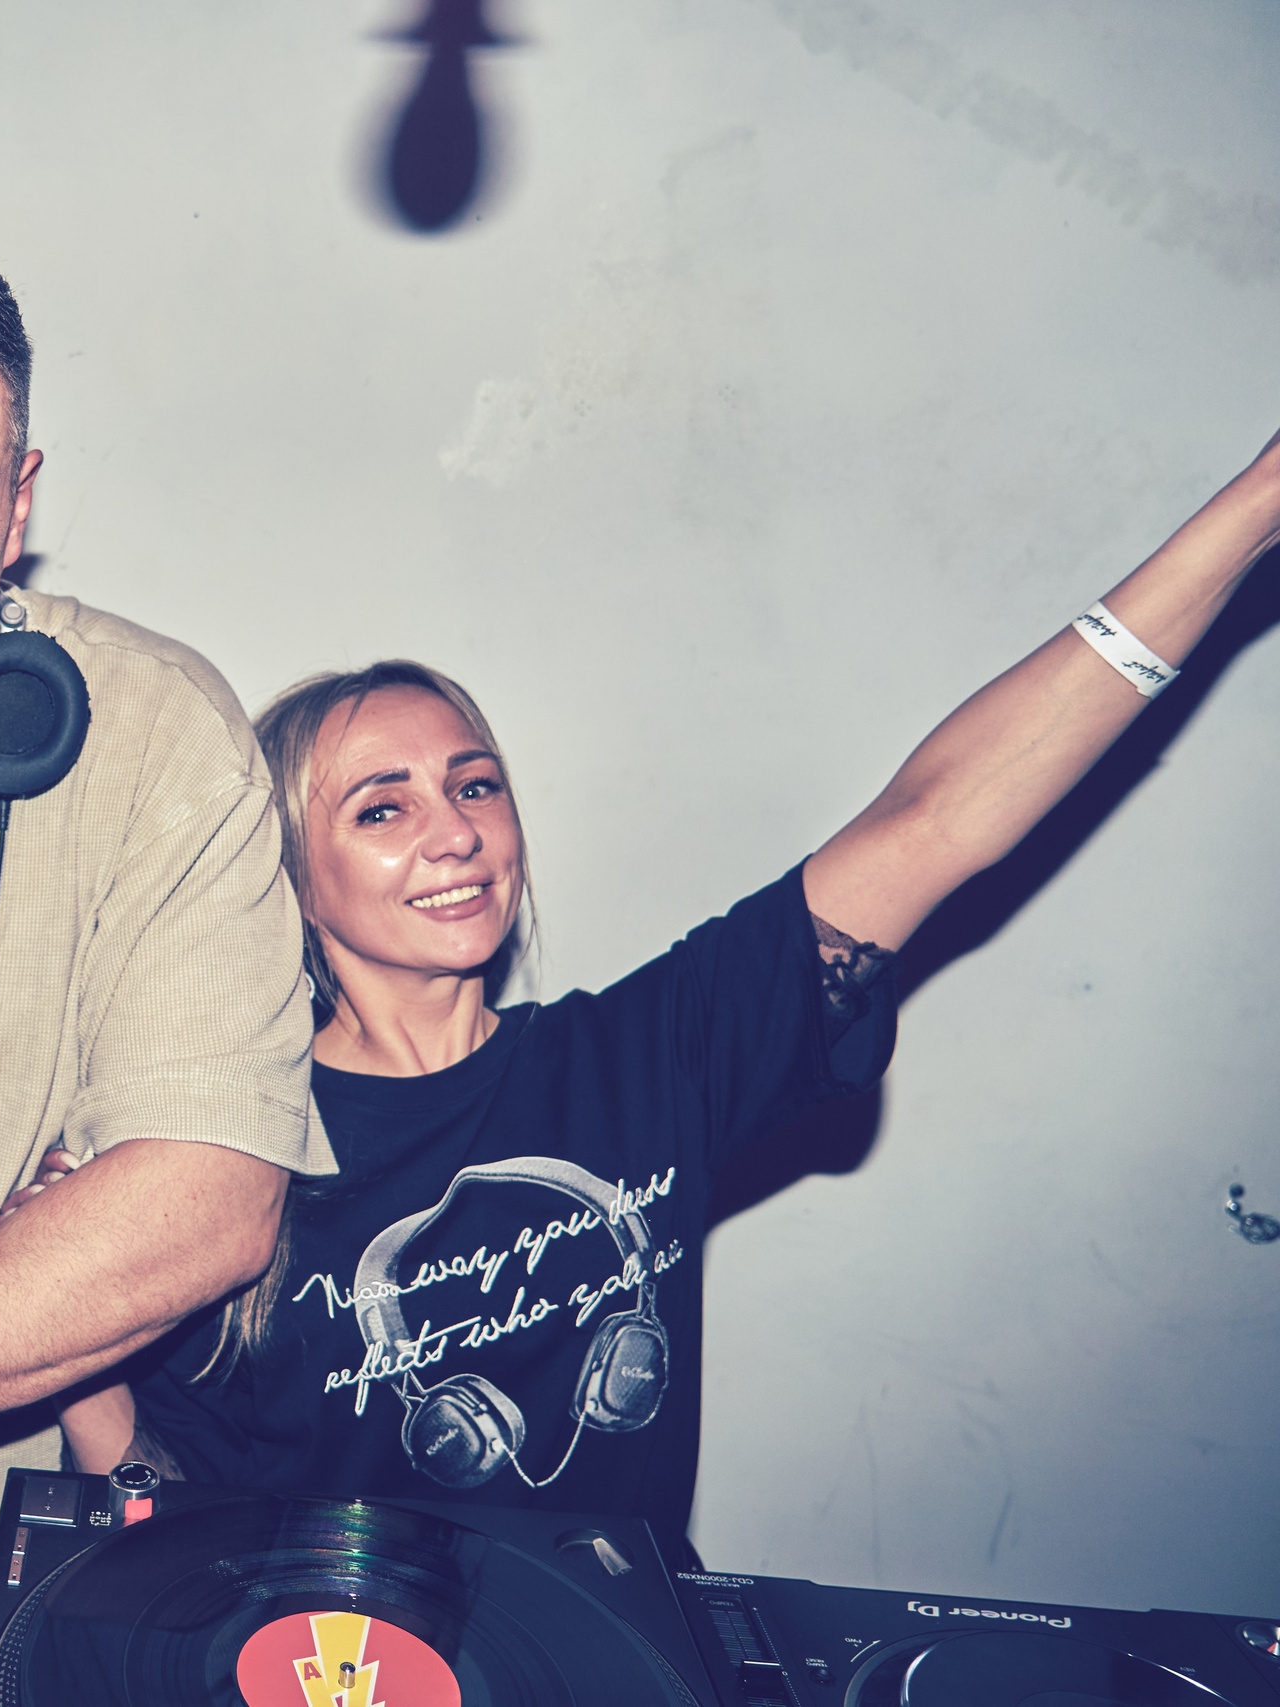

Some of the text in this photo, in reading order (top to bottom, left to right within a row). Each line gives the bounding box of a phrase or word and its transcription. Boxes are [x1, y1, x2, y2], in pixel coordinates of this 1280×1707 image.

[459, 1286, 559, 1348] who
[676, 1572, 754, 1585] CDJ-2000NXS2
[948, 1607, 1072, 1629] Pioneer
[303, 1662, 322, 1681] A
